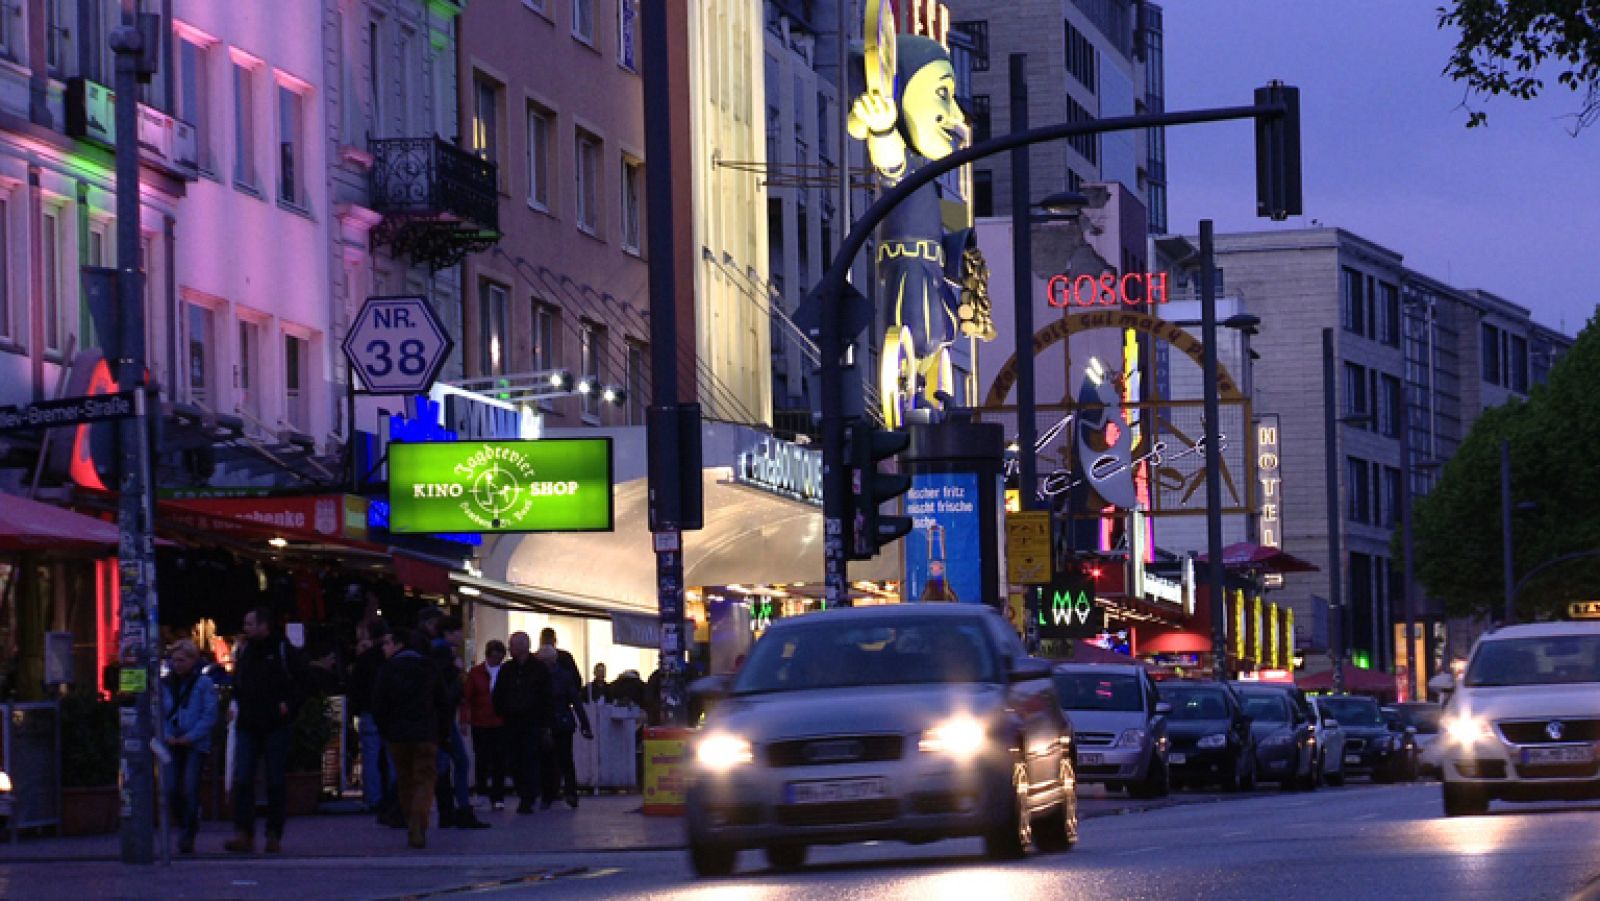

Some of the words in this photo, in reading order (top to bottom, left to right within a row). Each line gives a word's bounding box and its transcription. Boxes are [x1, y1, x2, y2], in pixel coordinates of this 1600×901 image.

[1046, 271, 1169, 308] GOSCH
[373, 307, 416, 329] NR.
[365, 339, 427, 377] 38
[0, 395, 130, 427] ev-Bremer-Straße
[412, 483, 464, 499] KINO
[529, 481, 579, 497] SHOP
[1258, 426, 1282, 547] HOTEL
